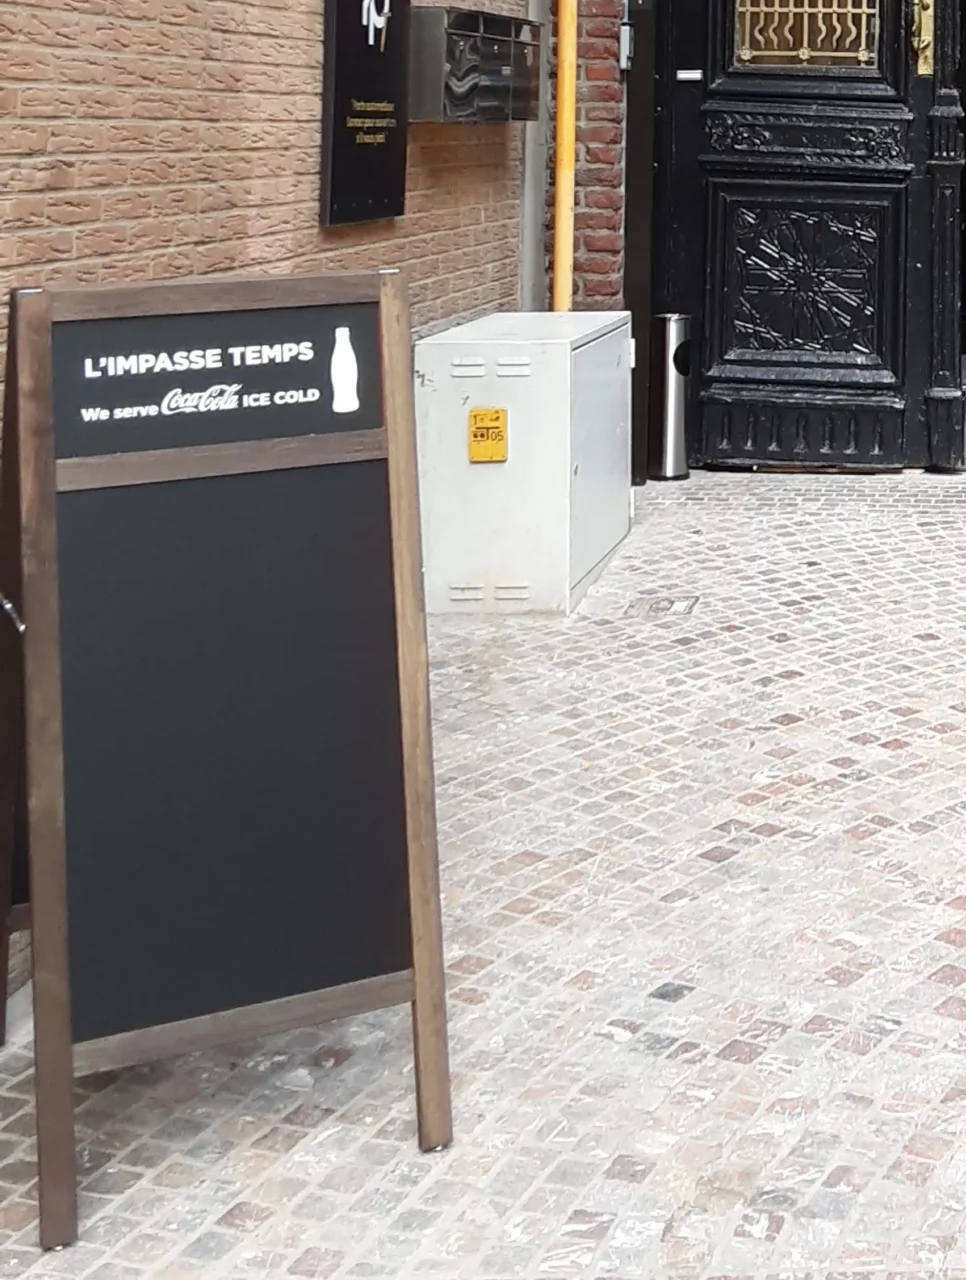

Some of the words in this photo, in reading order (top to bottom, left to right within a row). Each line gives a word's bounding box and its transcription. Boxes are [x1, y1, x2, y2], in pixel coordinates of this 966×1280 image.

[84, 348, 222, 378] L'IMPASSE
[228, 341, 315, 366] TEMPS
[81, 407, 110, 421] We
[113, 404, 159, 420] serve
[242, 392, 271, 407] ICE
[273, 388, 321, 405] COLD
